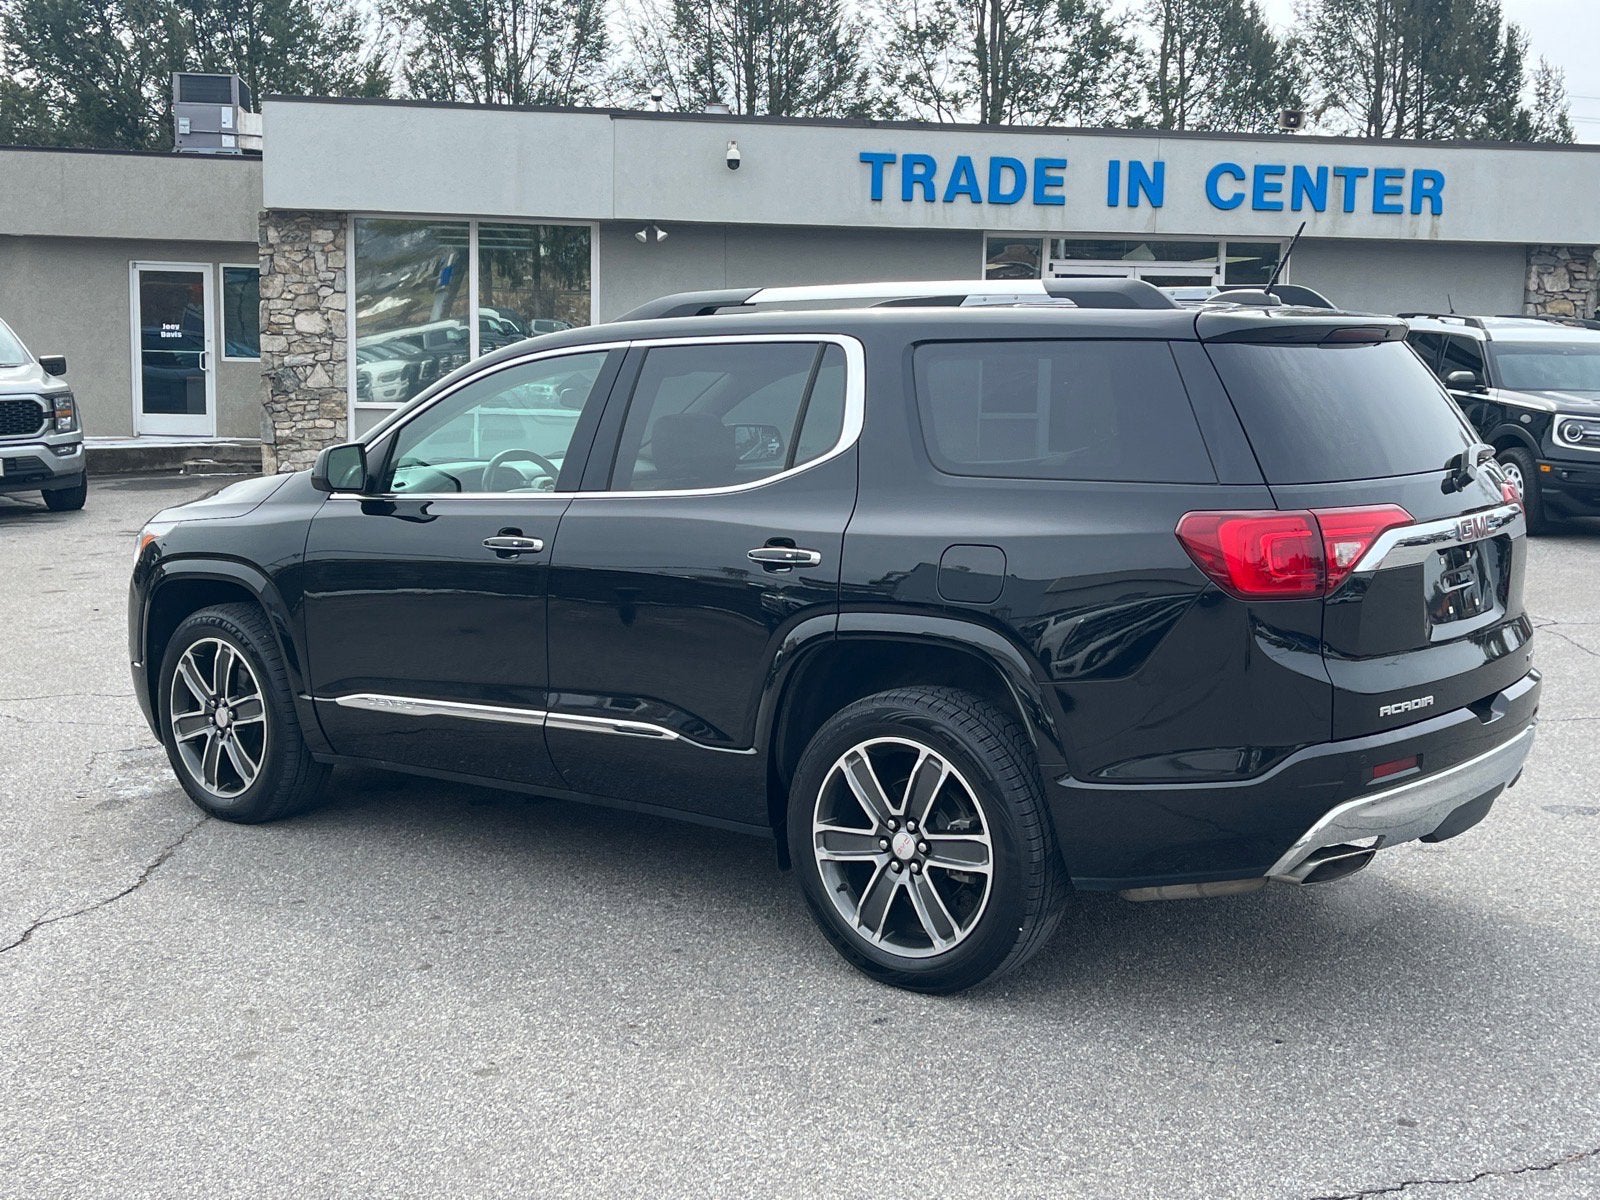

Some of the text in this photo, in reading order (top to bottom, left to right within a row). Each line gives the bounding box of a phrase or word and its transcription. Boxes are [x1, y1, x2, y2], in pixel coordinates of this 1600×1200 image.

[859, 152, 1445, 215] TRADE IN CENTER
[1460, 514, 1497, 540] GMC
[1379, 695, 1434, 717] ACADIA
